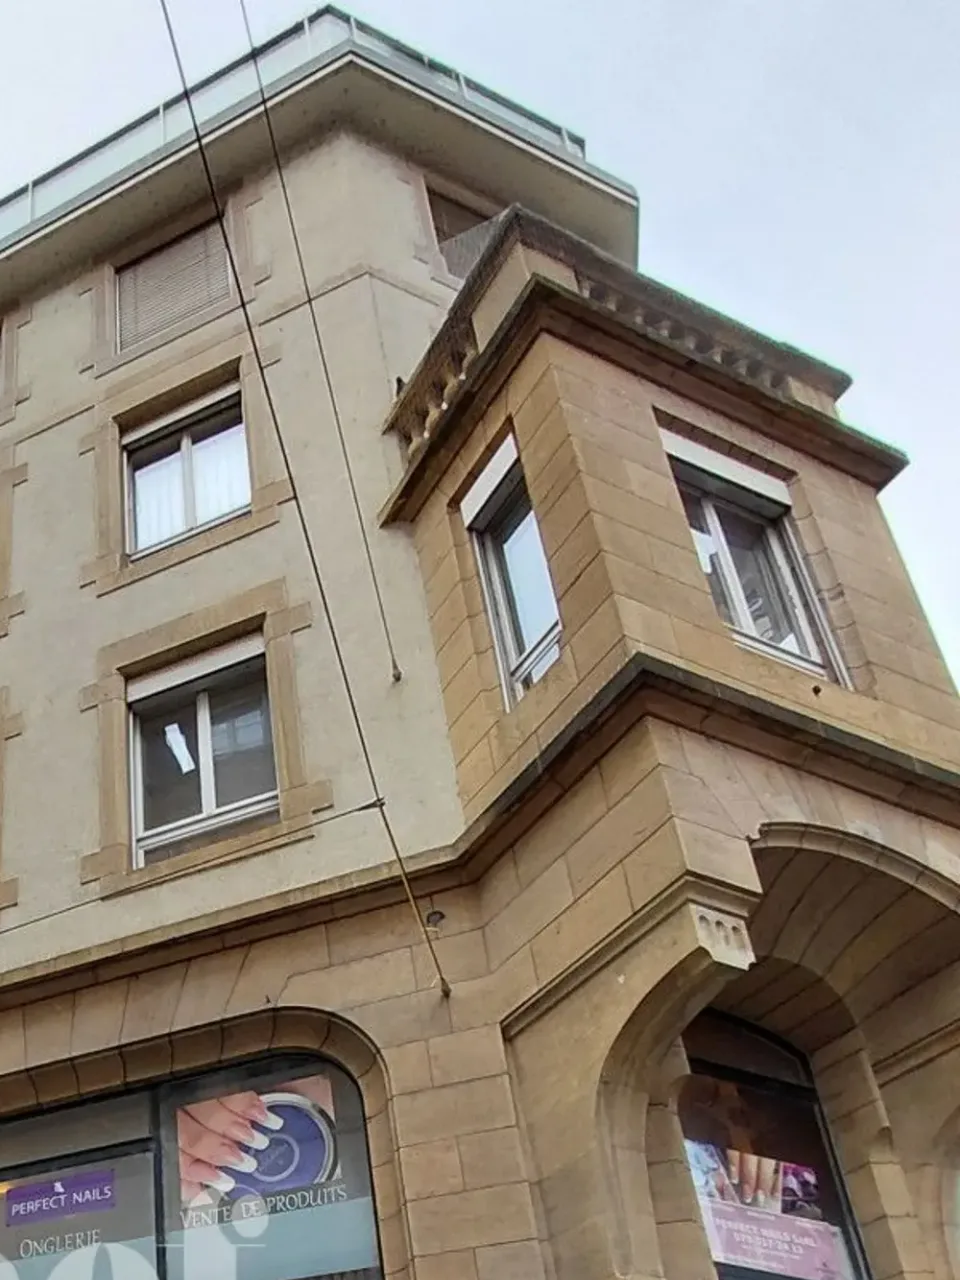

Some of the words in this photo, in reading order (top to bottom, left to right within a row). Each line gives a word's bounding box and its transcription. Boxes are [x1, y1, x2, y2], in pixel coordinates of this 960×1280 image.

[11, 1194, 68, 1217] PERFECT
[72, 1185, 113, 1205] NAILS
[179, 1206, 232, 1229] VENTE
[241, 1200, 262, 1219] DE
[265, 1183, 348, 1213] PRODUITS
[19, 1228, 101, 1259] ONGLERIE
